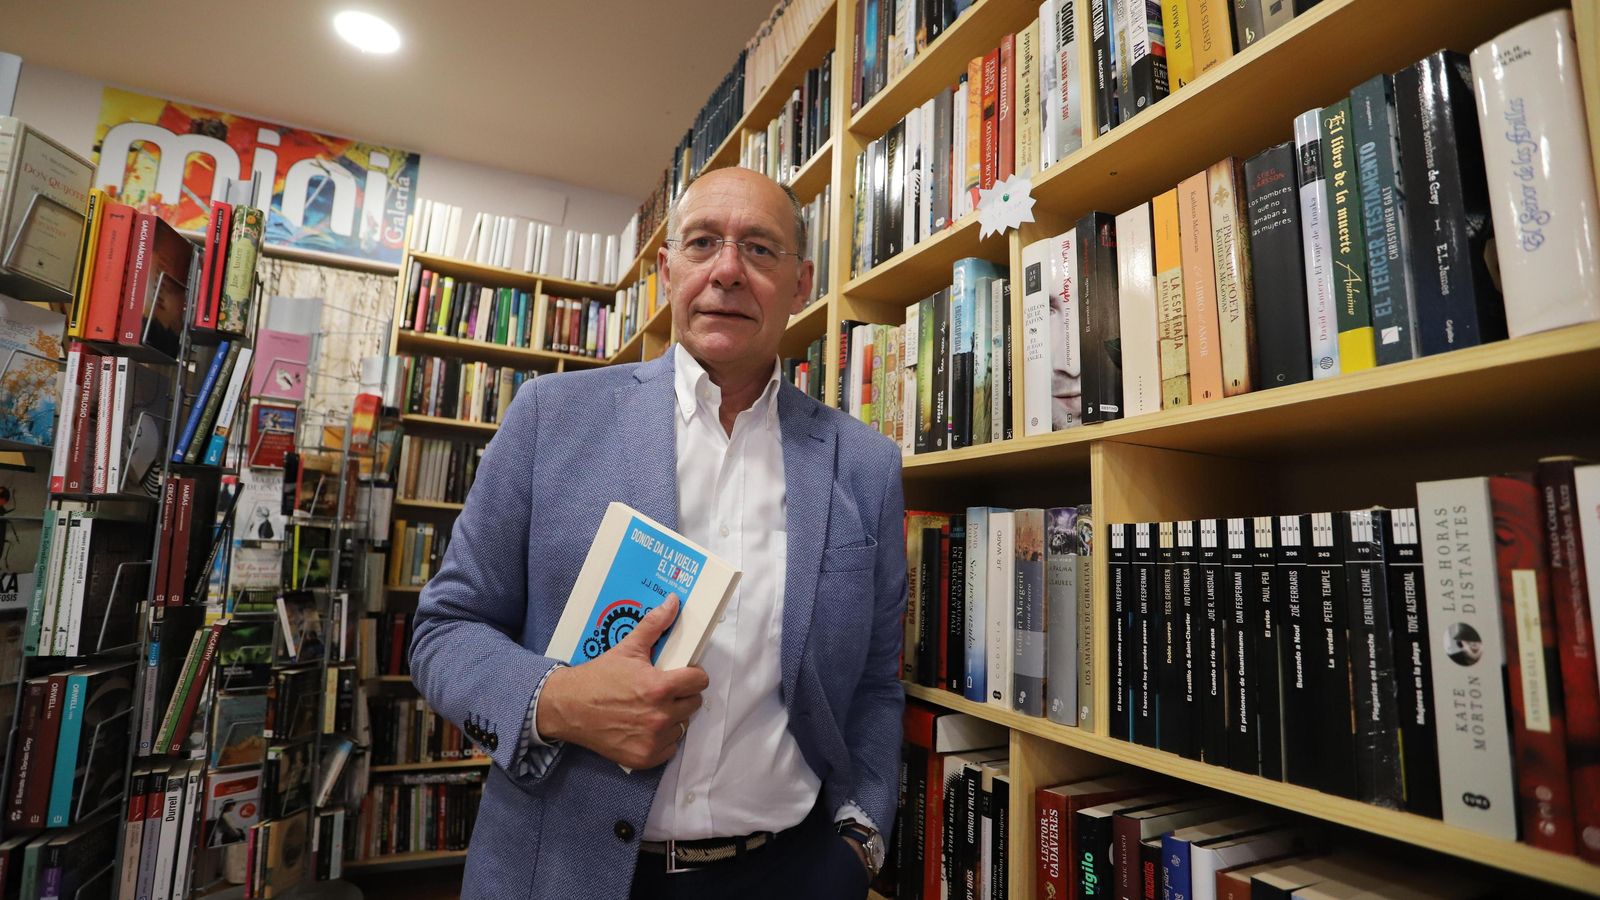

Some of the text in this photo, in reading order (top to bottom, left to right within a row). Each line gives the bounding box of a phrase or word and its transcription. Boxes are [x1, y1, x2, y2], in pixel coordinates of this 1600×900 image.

[1061, 0, 1074, 47] MUNDO
[1172, 4, 1182, 50] BLAS MALO
[1200, 0, 1211, 50] GENTES DE
[1022, 32, 1032, 116] Sombra Inquisidor
[24, 162, 46, 182] DON
[94, 121, 389, 242] mini
[1260, 186, 1292, 202] hombres
[1324, 110, 1354, 254] El libro de la muerte
[1504, 98, 1550, 252] El Señor de los Anillos
[1190, 192, 1198, 218] Kathleen
[1254, 210, 1281, 225] amaban
[1381, 186, 1399, 260] CHRISTOPHER GALT
[136, 220, 148, 270] GARCÍA MÁRQUEZ
[1191, 220, 1200, 252] McGowan
[1214, 228, 1224, 270] KATHLEEN
[1359, 141, 1392, 316] EL TERCER TESTAMENTO
[232, 247, 242, 270] Austen
[1222, 224, 1239, 322] PRÍNCIPE POETA
[1308, 197, 1328, 342] David Cantero El viaje de Tanaka
[1436, 243, 1451, 296] E.L. James
[1336, 260, 1362, 316] Anónimo
[954, 305, 962, 352] ENCICLOPEDIA
[1170, 276, 1184, 350] LA ESPERADA
[80, 362, 94, 418] SÁNCHEZ FERLOSIO
[166, 484, 174, 504] CERCAS
[182, 484, 190, 506] MARÍAS
[1544, 487, 1562, 567] PAULO COELHO
[631, 528, 699, 575] DONDE DA LA VUELTA
[658, 559, 668, 573] EL
[1434, 507, 1456, 612] LAS HORAS
[1452, 504, 1476, 614] DISTANTES
[641, 578, 652, 588] J.J.
[652, 584, 667, 598] Díaz
[908, 567, 916, 600] SANTA
[1016, 572, 1024, 616] Margerit
[1290, 571, 1300, 616] ZOË FERRARIS
[1322, 570, 1332, 622] PETER TEMPLE
[1362, 570, 1373, 624] DENNIS LEHANE
[1405, 573, 1418, 632] TOVE ALSTERDAL
[1084, 613, 1090, 622] DE
[204, 631, 219, 660] McCARTHY
[1328, 659, 1334, 668] La
[48, 682, 58, 709] ORWELL
[70, 684, 79, 709] ORWELL
[1240, 678, 1244, 686] de
[1412, 642, 1424, 724] Mujeres en la playa
[1453, 689, 1468, 732] KATE
[1466, 675, 1486, 751] MORTON
[21, 752, 30, 770] Dorian
[23, 737, 32, 751] Gray
[16, 779, 26, 798] Retrato
[165, 796, 178, 822] Durrell
[1041, 818, 1049, 862] LECTOR
[1048, 808, 1059, 878] CADÁVERES
[1082, 852, 1098, 895] vigilo
